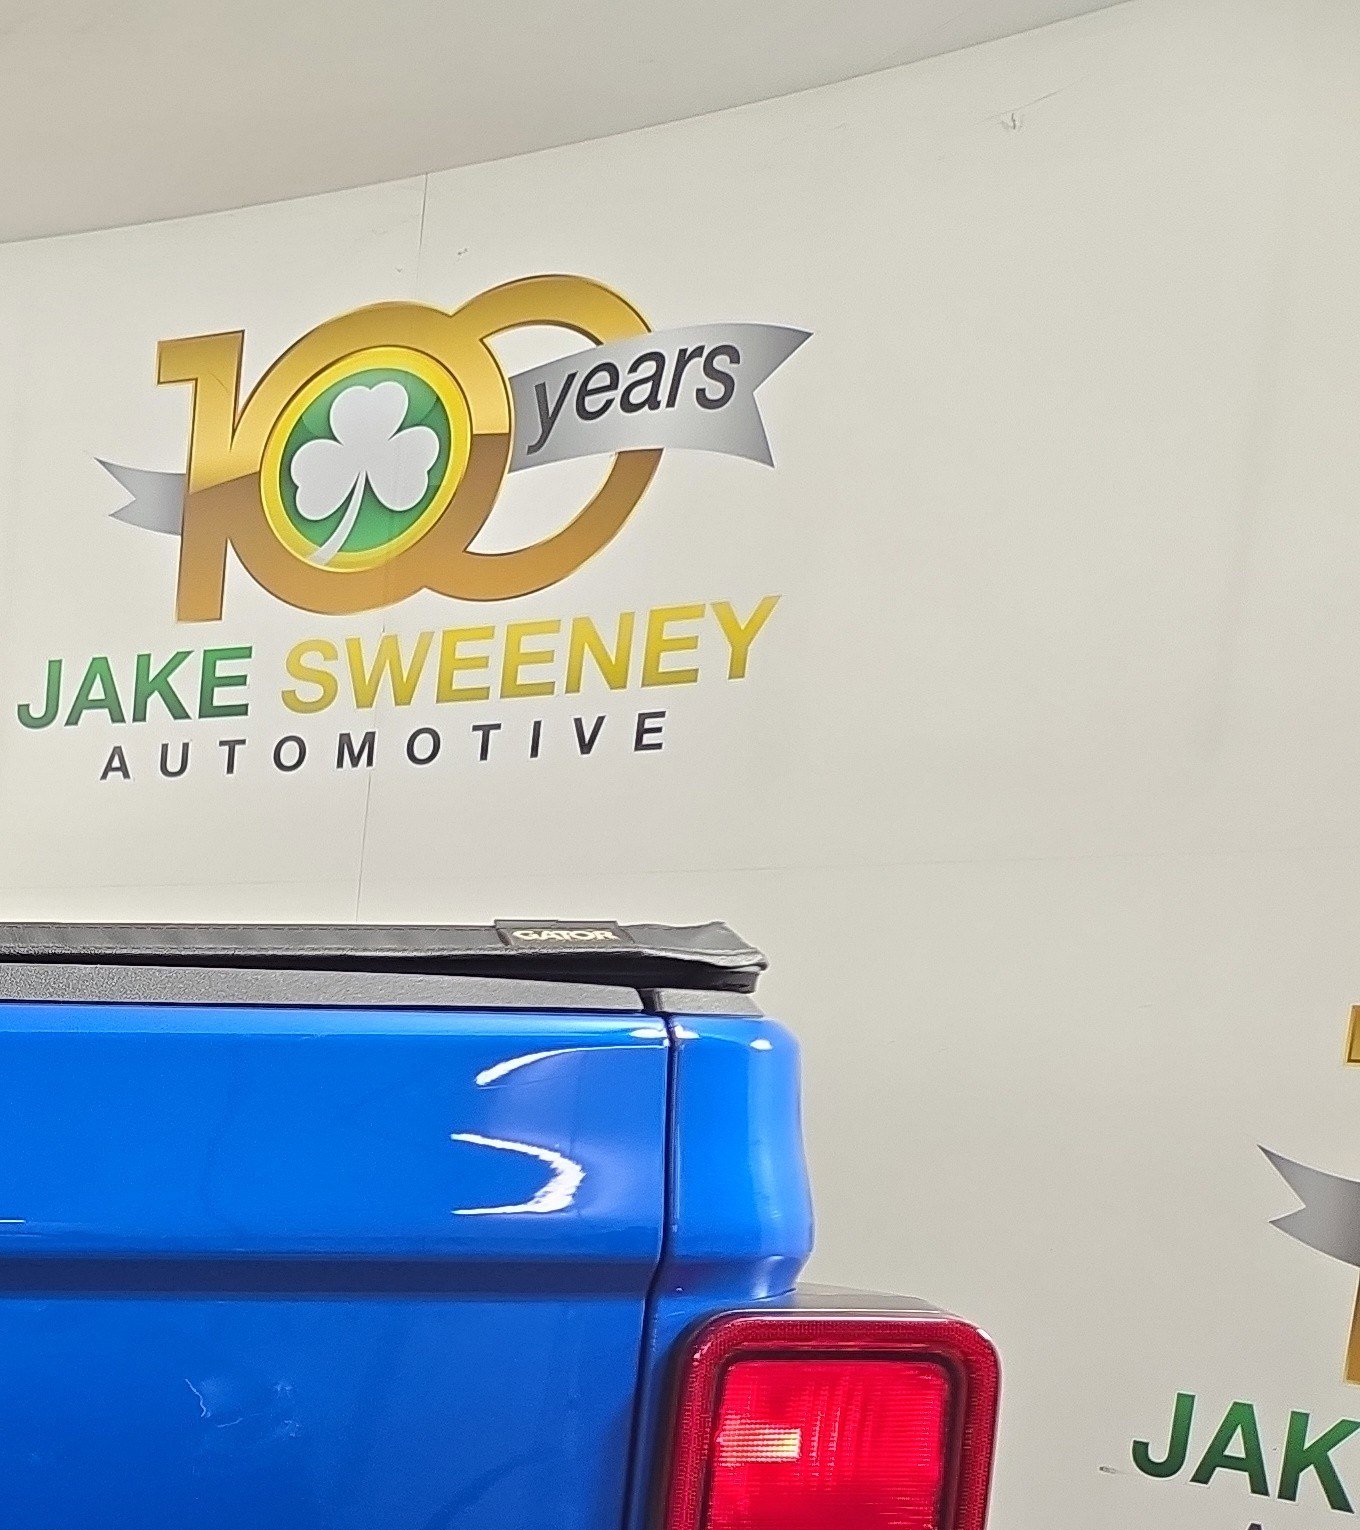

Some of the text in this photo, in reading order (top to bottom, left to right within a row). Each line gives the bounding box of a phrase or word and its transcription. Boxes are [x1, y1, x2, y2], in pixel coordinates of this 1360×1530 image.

[526, 342, 742, 455] years
[17, 595, 782, 731] JAKE SWEENEY
[100, 710, 667, 783] AUTOMOTIVE
[512, 930, 620, 941] GATOR
